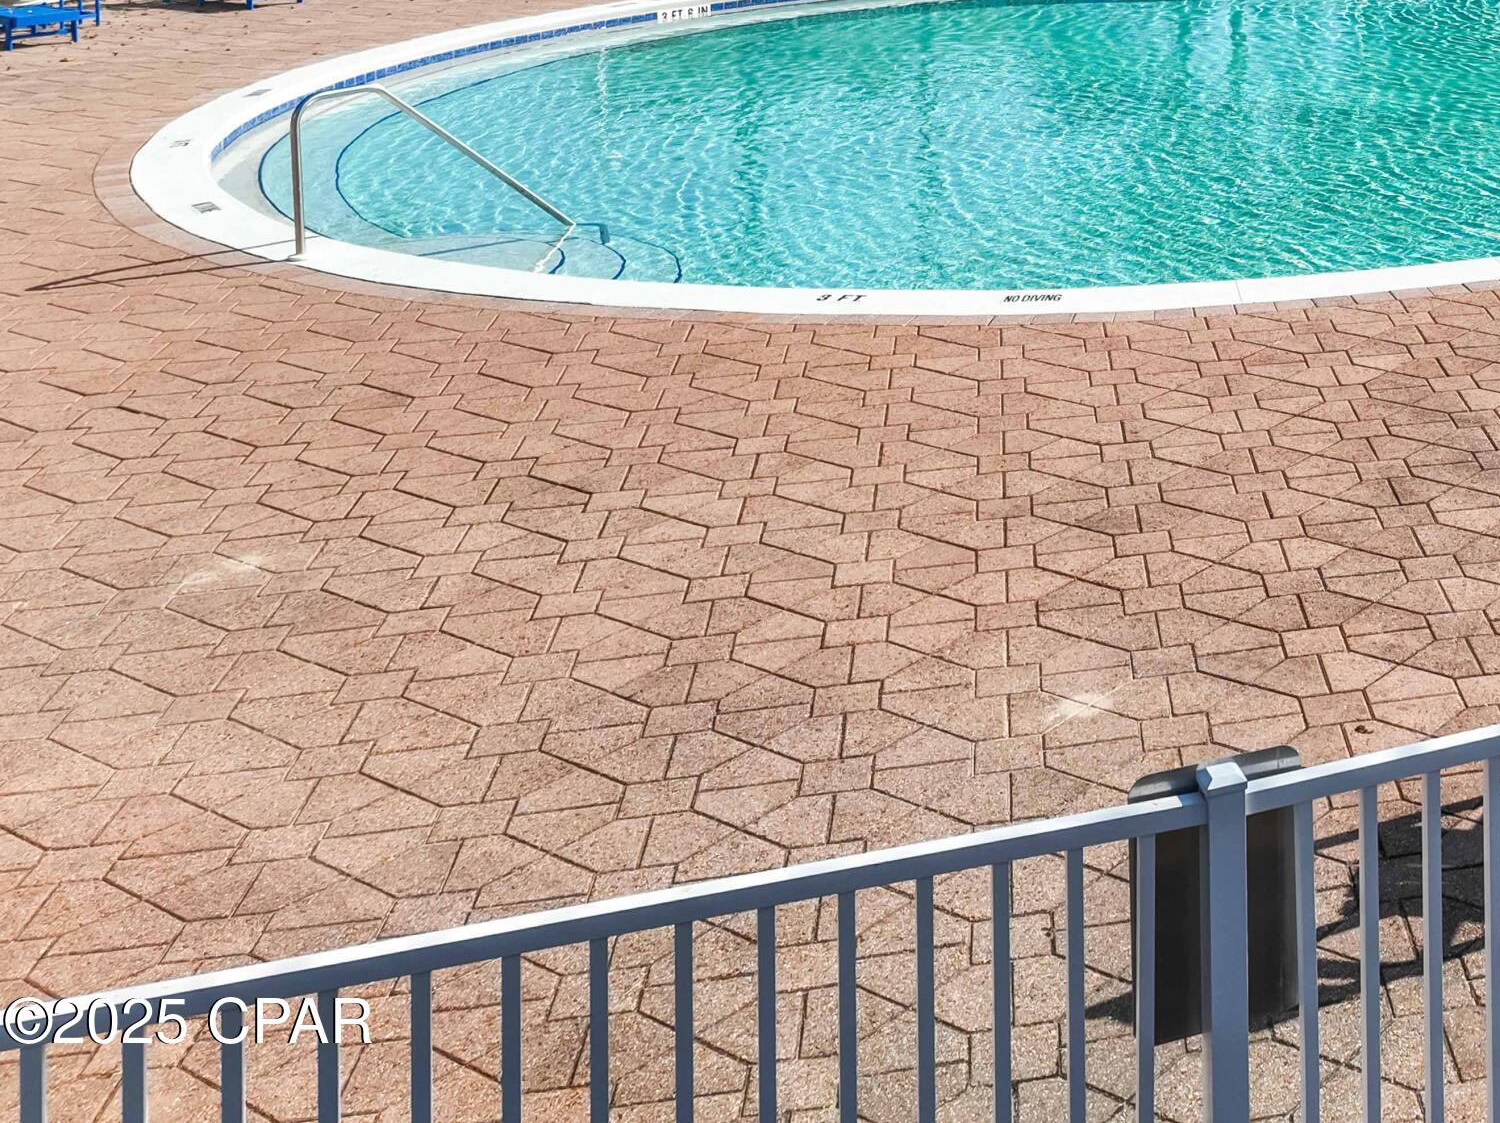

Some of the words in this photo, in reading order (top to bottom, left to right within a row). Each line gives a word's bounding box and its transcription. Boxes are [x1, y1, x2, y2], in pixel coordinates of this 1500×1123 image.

[671, 9, 683, 18] FT
[697, 5, 708, 14] IN
[816, 294, 832, 302] 3
[836, 294, 867, 303] FT
[1003, 294, 1020, 303] NO
[1020, 293, 1062, 303] DIVING
